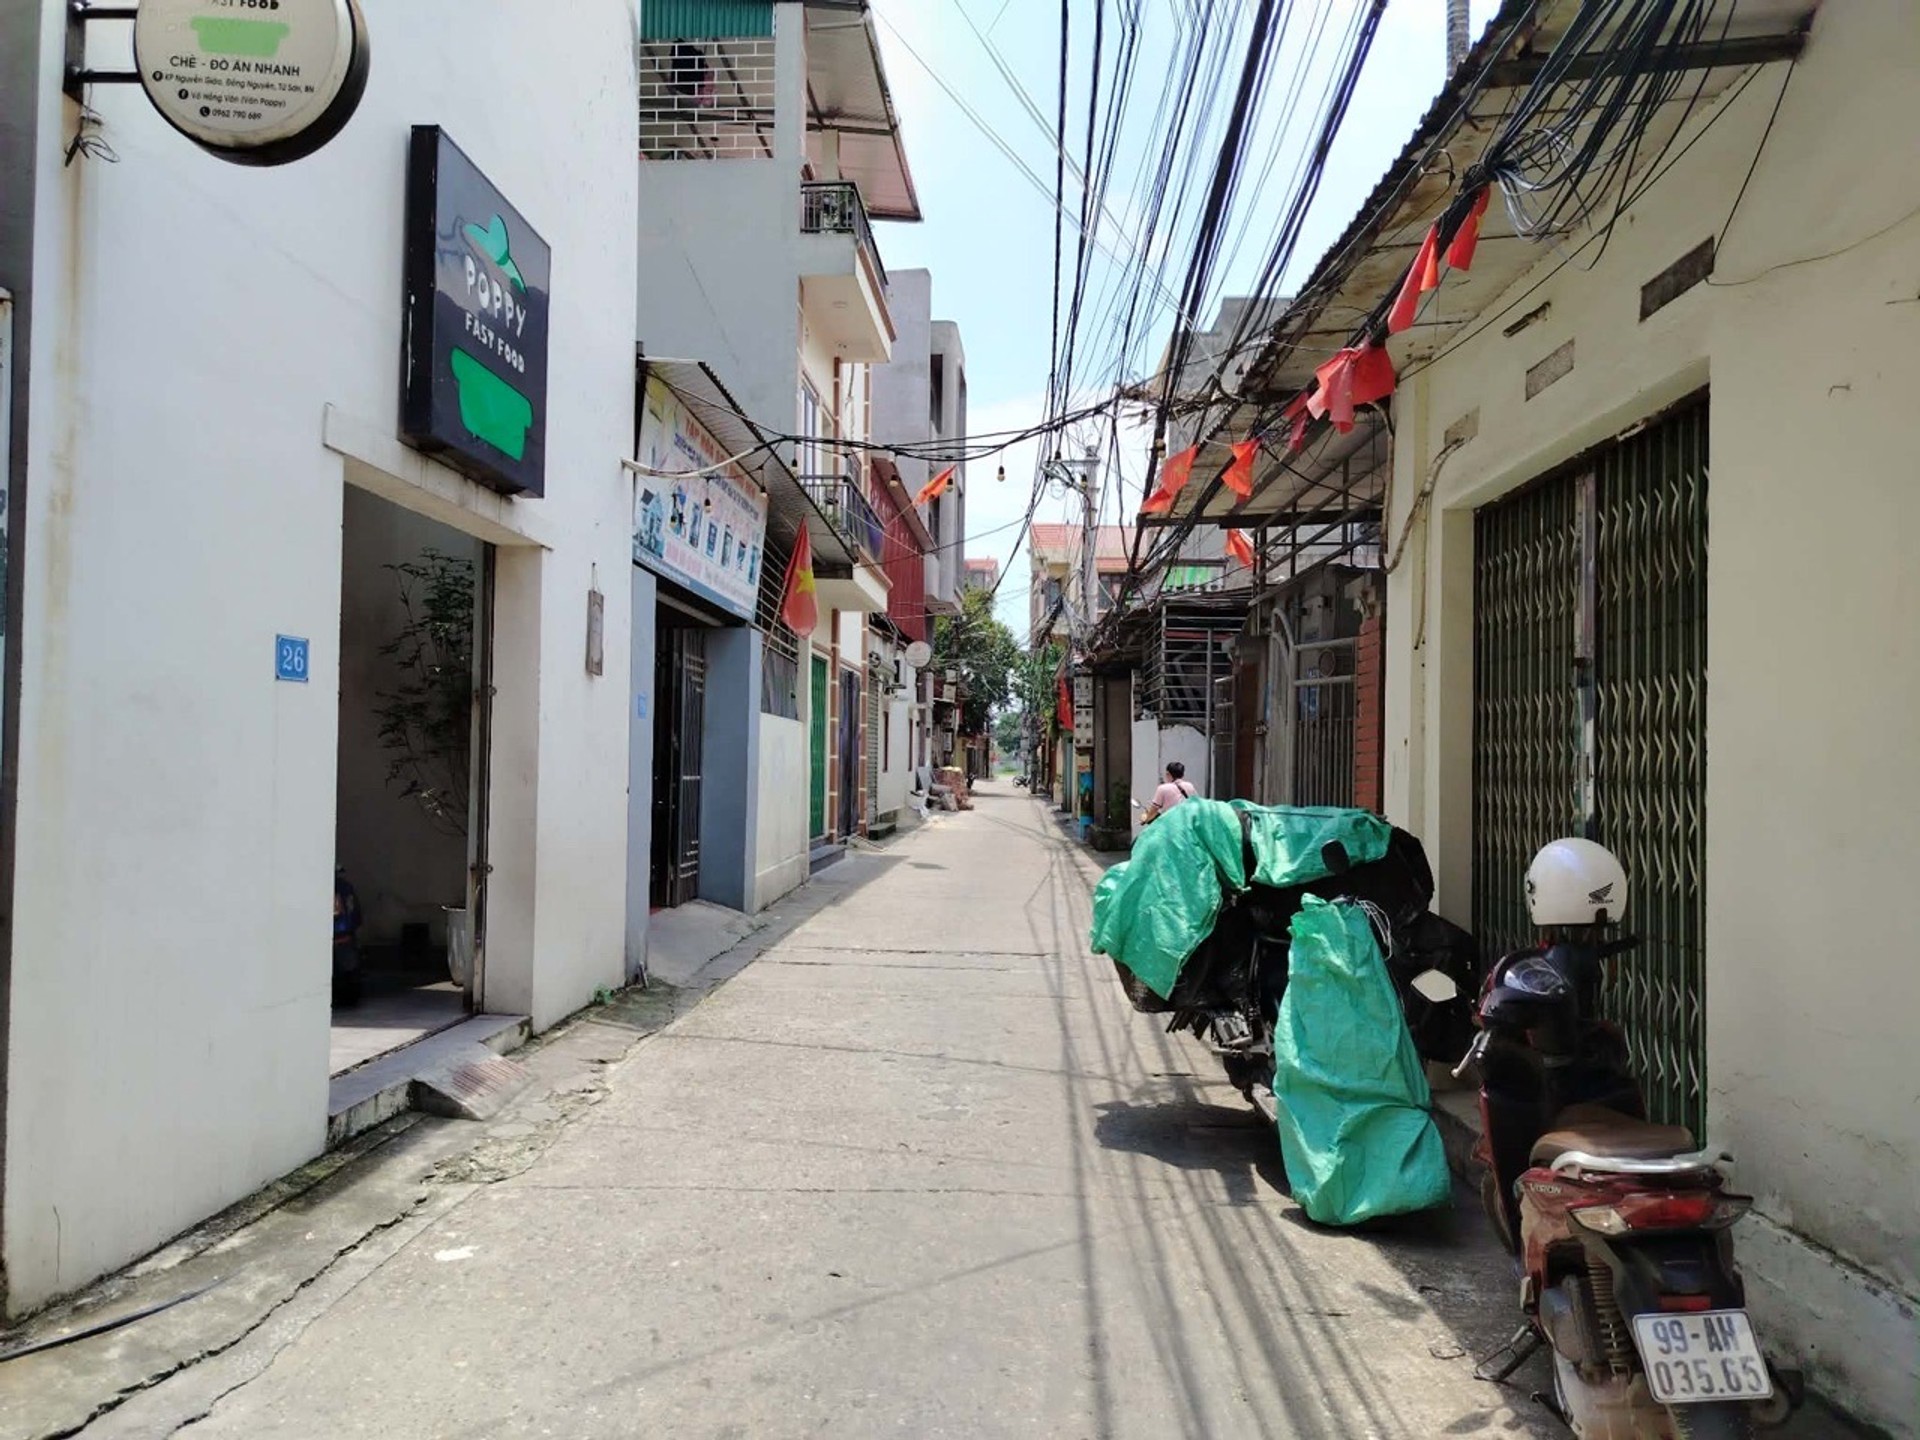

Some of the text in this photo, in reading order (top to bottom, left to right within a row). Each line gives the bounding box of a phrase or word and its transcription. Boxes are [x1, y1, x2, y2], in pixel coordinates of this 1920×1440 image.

[254, 62, 300, 77] NHANH
[465, 254, 526, 339] POPPY
[465, 311, 525, 374] FAST FOOD
[282, 645, 304, 672] 26
[1529, 1182, 1562, 1195] VISION
[1652, 1316, 1740, 1355] 99-AH
[1654, 1355, 1763, 1396] 035.65
